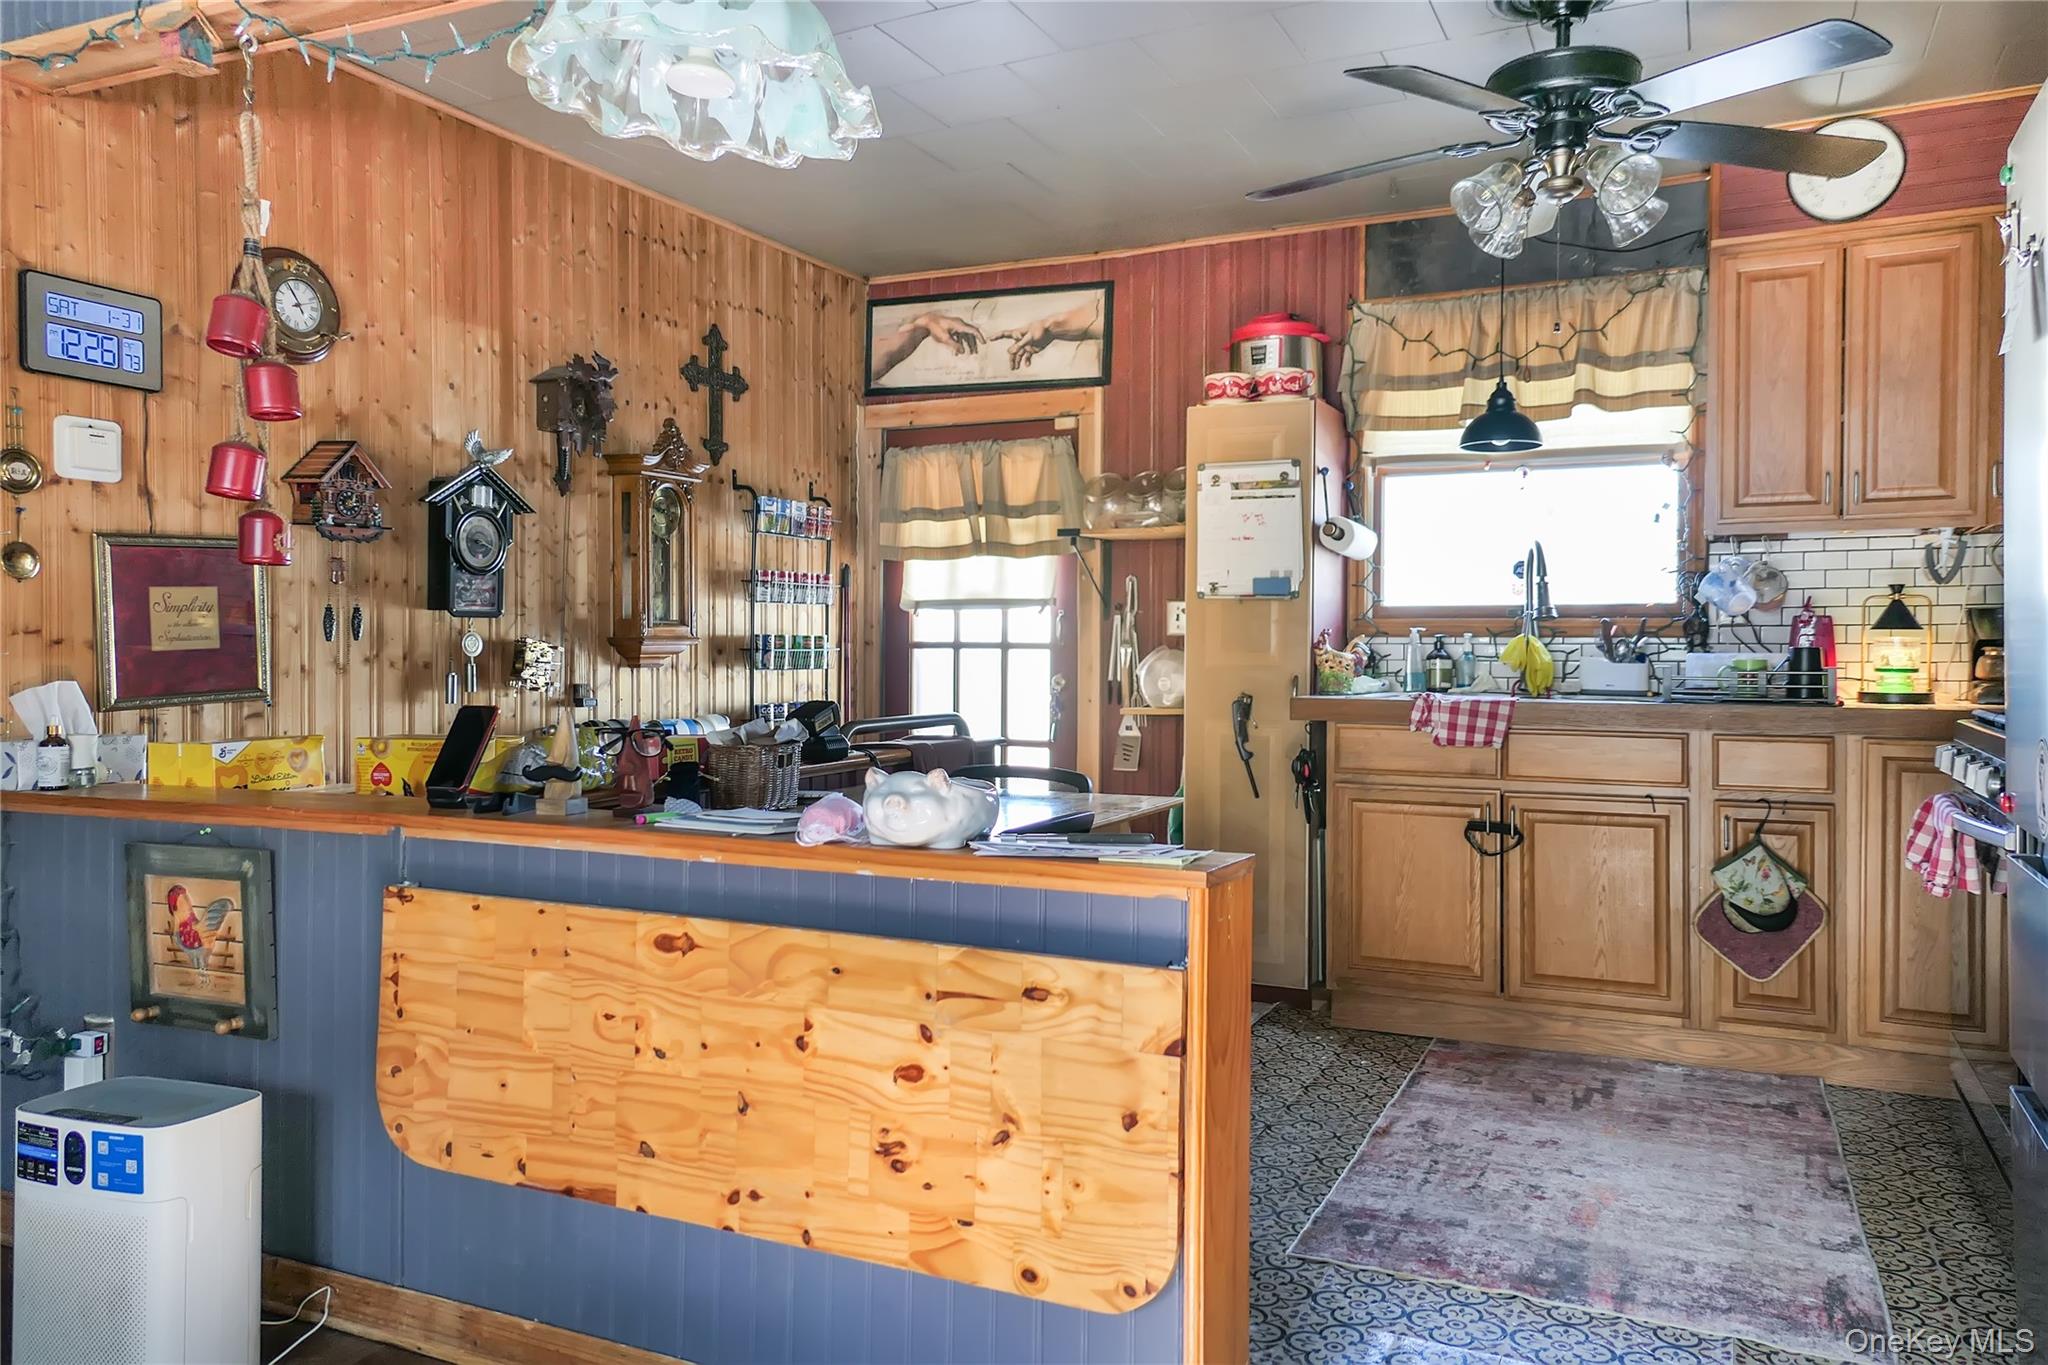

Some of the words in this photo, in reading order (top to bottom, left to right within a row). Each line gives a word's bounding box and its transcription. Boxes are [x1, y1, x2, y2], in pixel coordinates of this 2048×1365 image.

[48, 296, 79, 316] SAT
[125, 353, 141, 371] 73
[152, 591, 215, 618] Simplicity
